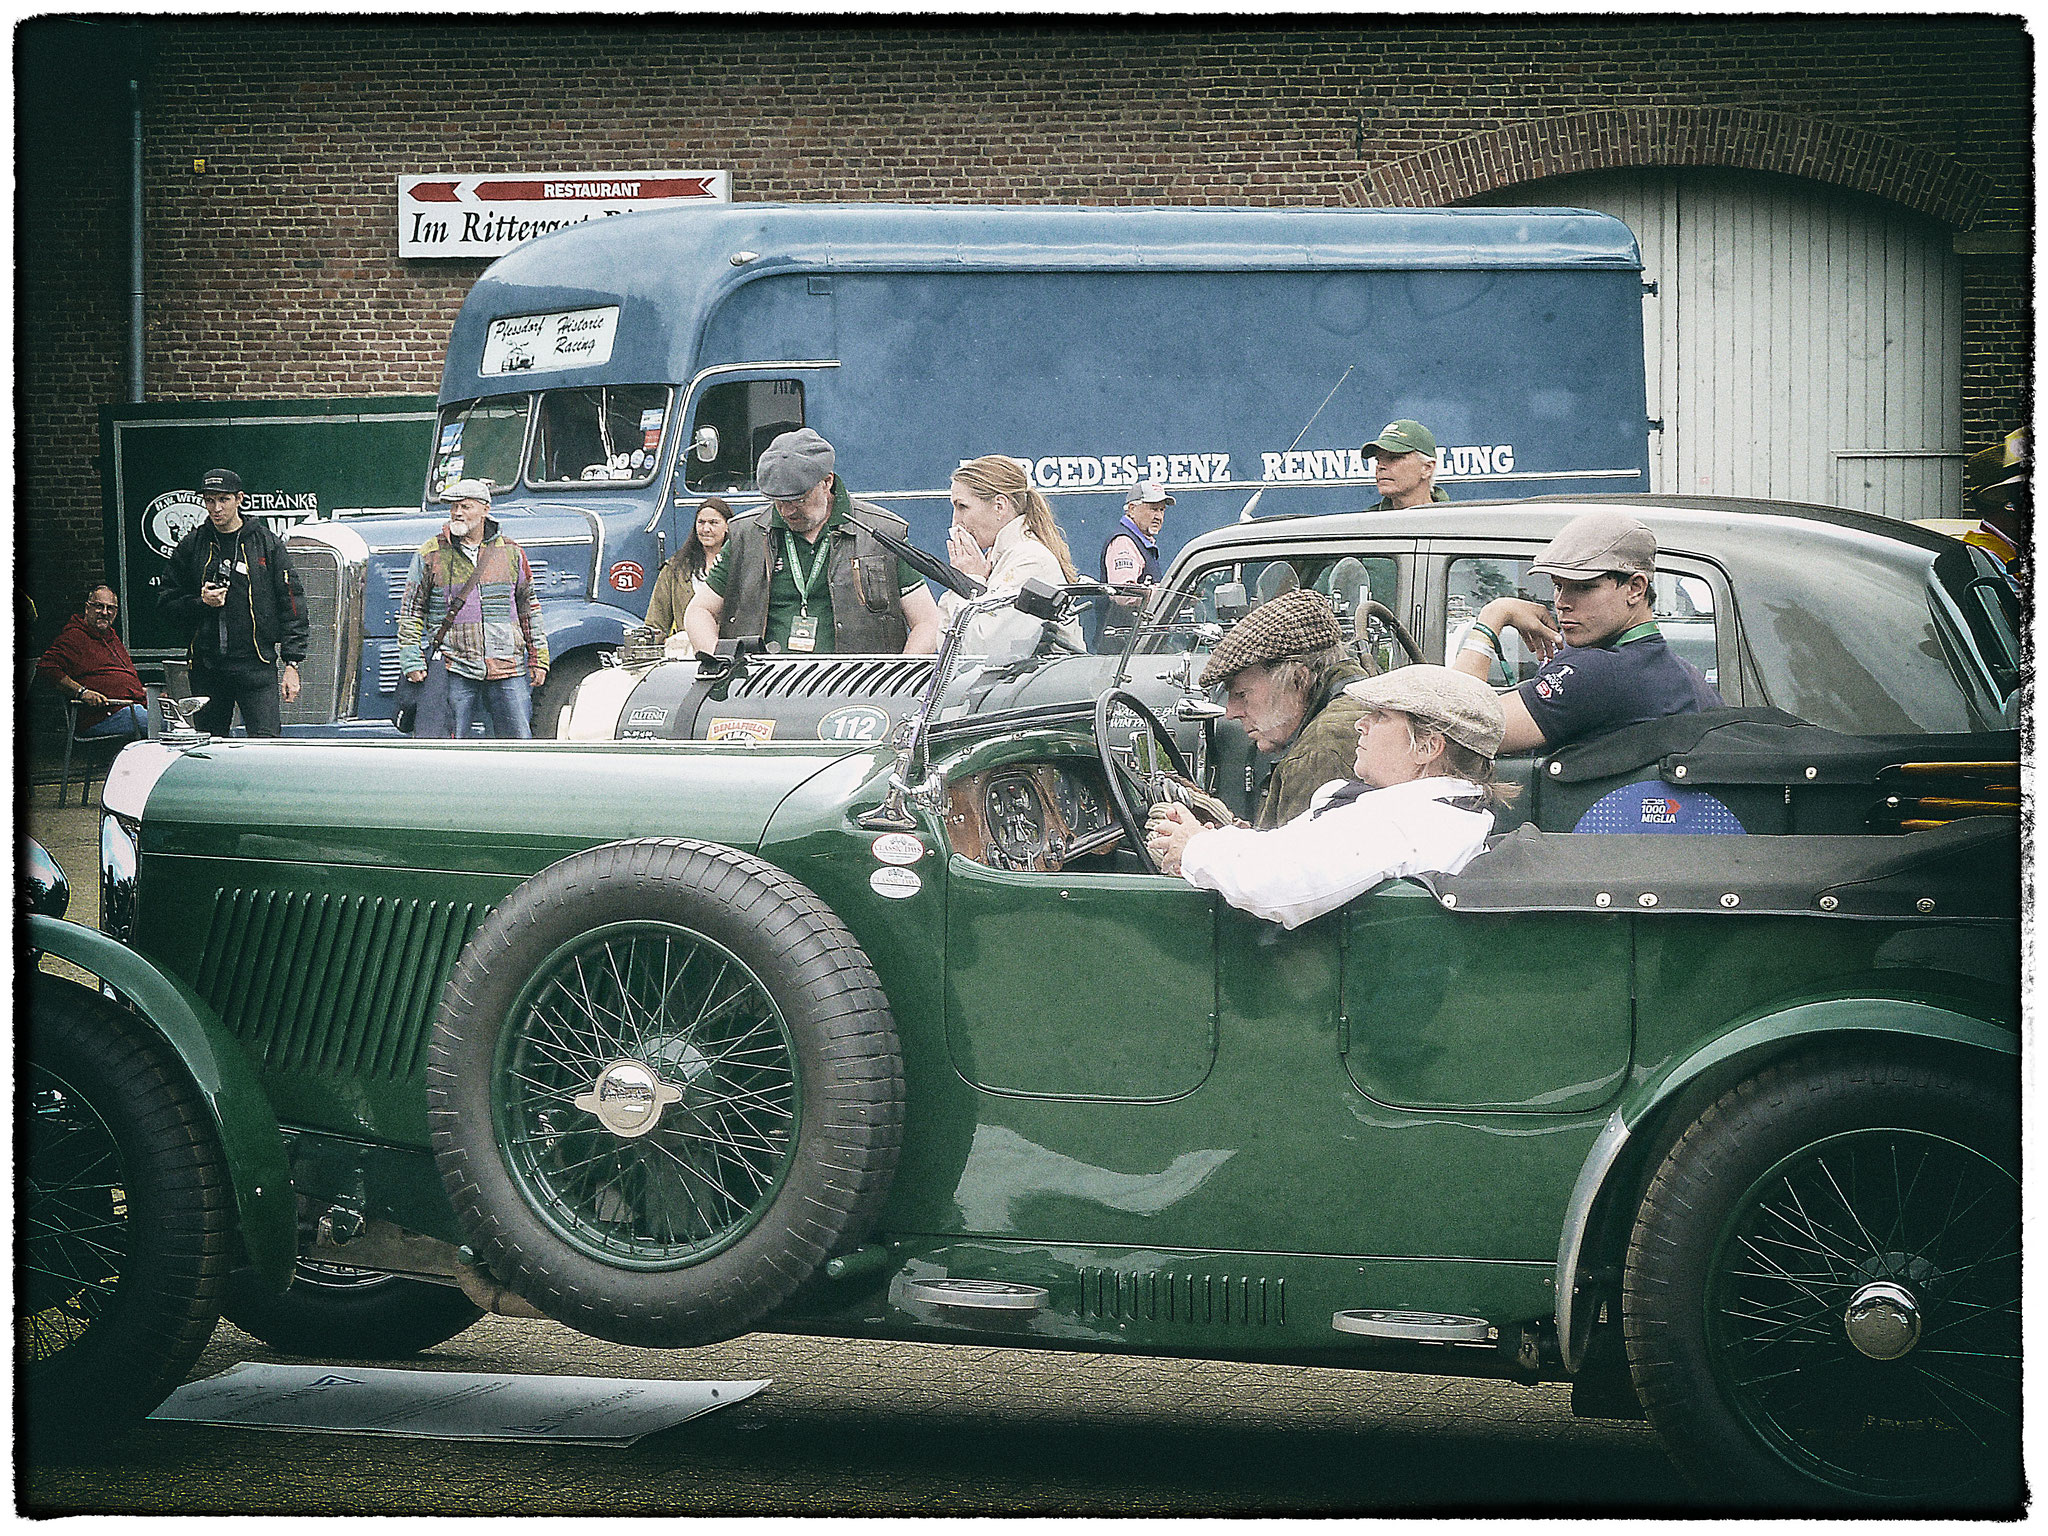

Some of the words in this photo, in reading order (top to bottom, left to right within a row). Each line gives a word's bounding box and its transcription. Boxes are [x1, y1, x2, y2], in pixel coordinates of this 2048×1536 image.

[543, 182, 642, 198] RESTAURANT
[408, 212, 449, 243] Im
[459, 210, 589, 243] Ritter
[557, 314, 605, 335] Historic
[553, 335, 596, 357] Racing
[959, 453, 1232, 488] RCEDES-BENZ
[617, 574, 633, 587] 51
[631, 710, 664, 720] ALTENA
[834, 716, 877, 740] 112
[1641, 805, 1666, 814] 1000
[1640, 814, 1677, 824] MIGLIA
